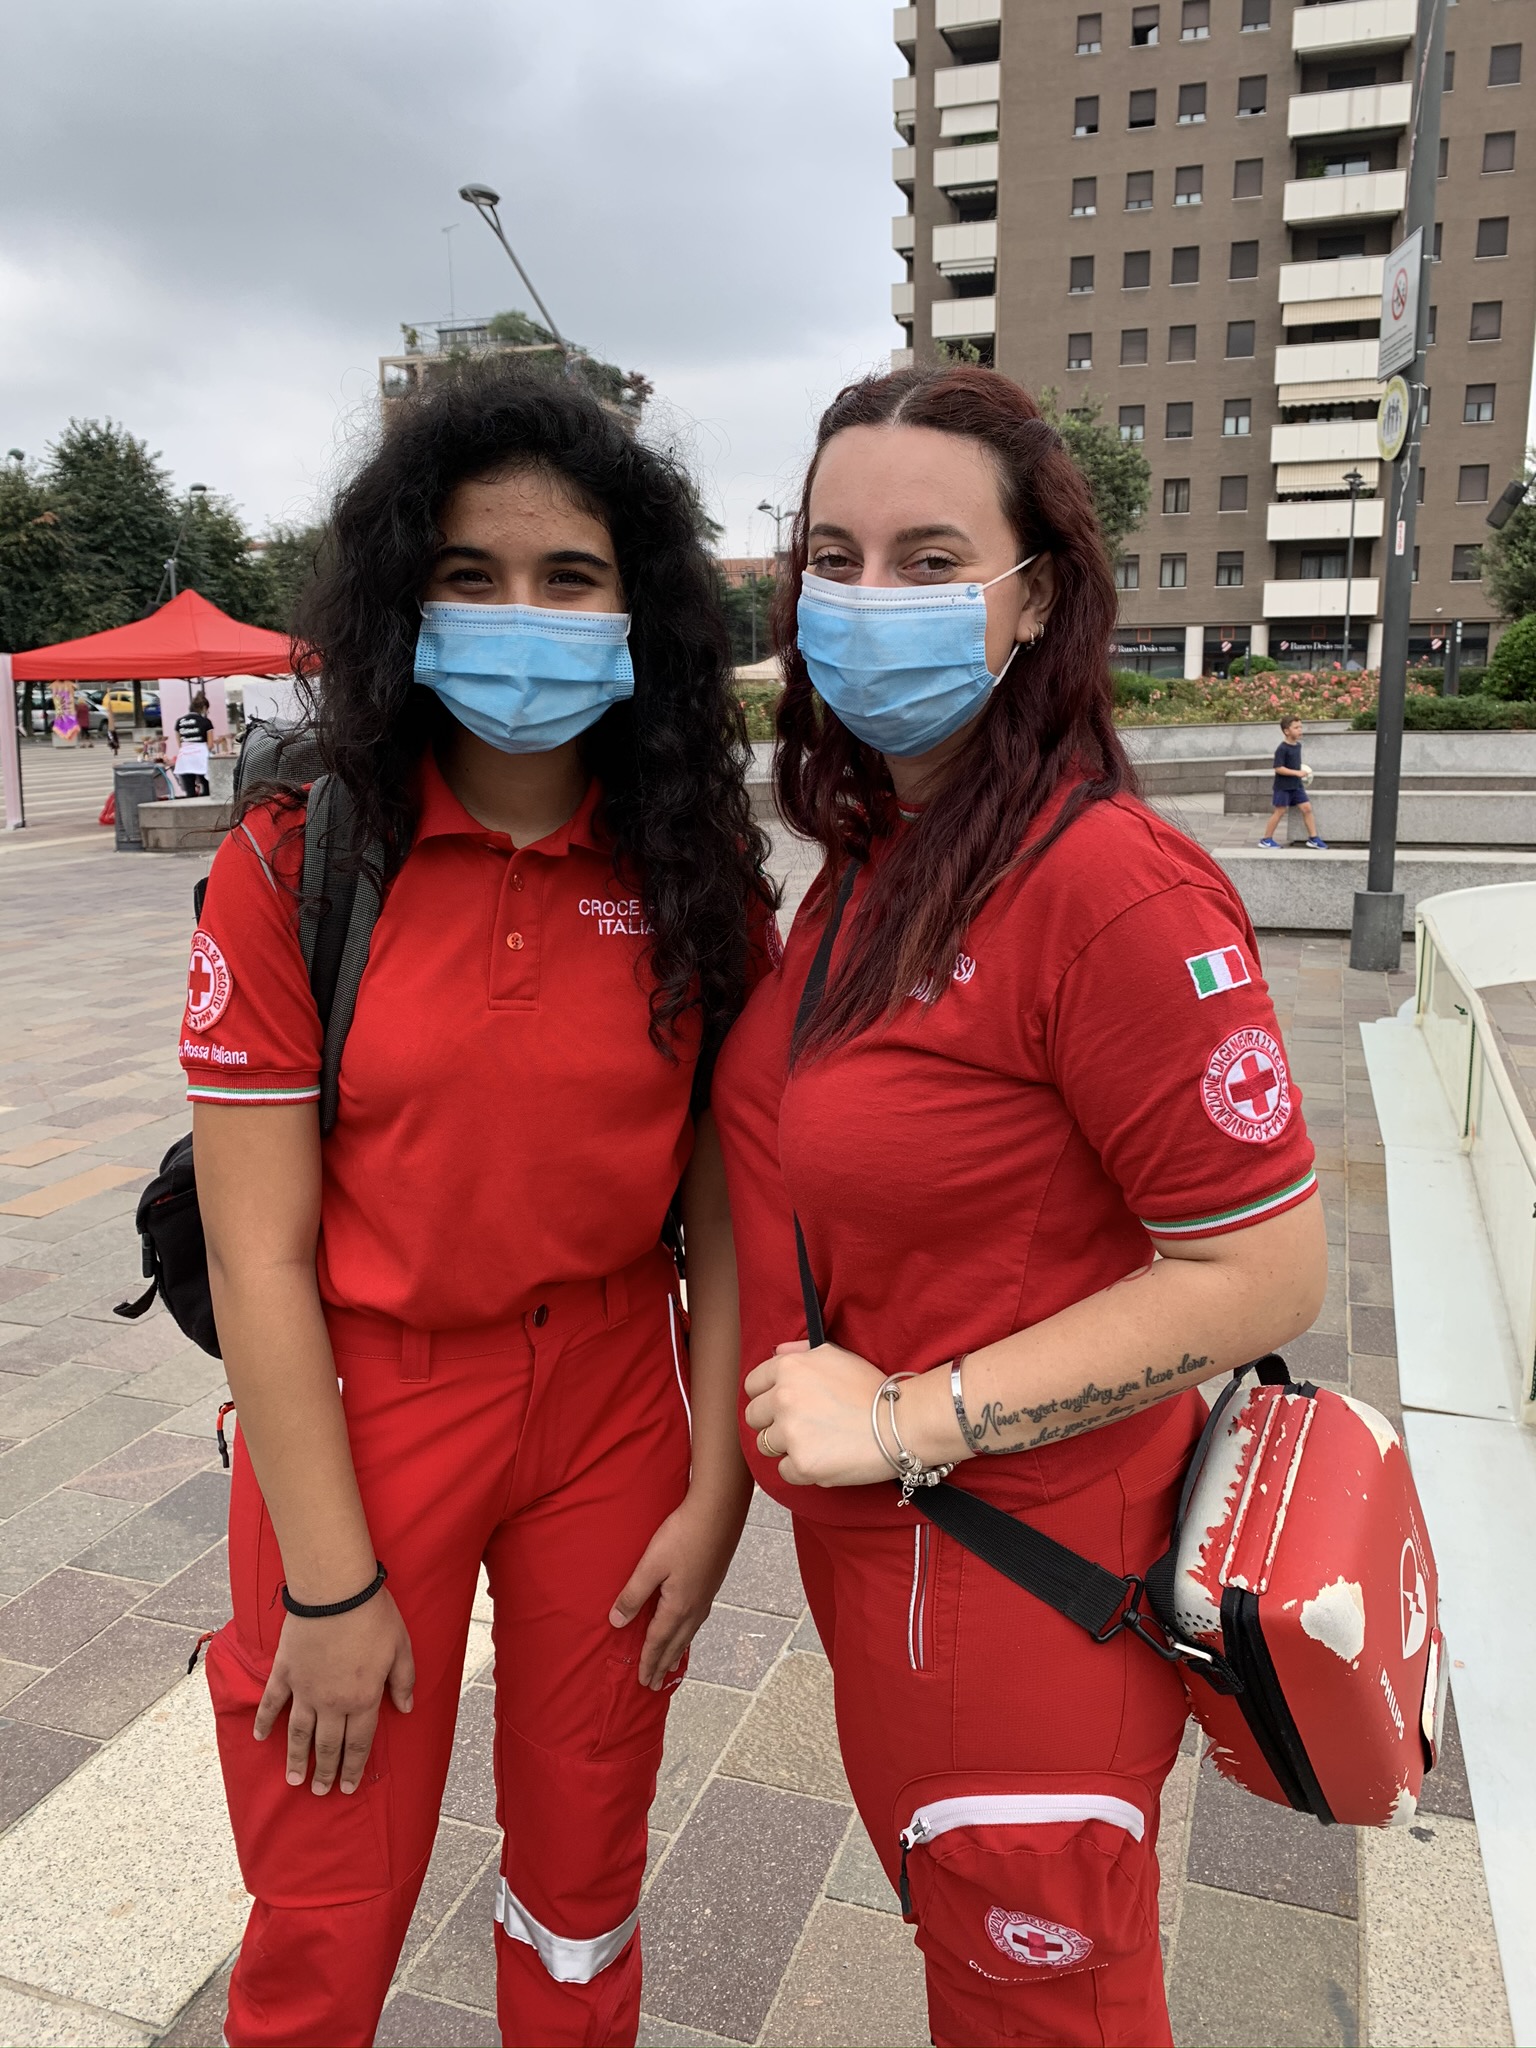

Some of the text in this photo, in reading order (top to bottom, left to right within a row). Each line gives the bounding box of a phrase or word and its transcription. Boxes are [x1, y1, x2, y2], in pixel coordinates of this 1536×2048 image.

[578, 898, 640, 917] CROCE
[598, 918, 658, 935] ITALIA
[211, 949, 220, 964] 22
[214, 966, 228, 1010] AGOSTO
[184, 1039, 210, 1060] Rossa
[211, 1043, 248, 1065] Italiana
[1217, 1031, 1261, 1061] GINEVRA
[1210, 1054, 1228, 1073] DI
[1271, 1046, 1290, 1104] AGOSTO
[1204, 1072, 1263, 1140] CONVENZIONE
[973, 1401, 1021, 1440] Never
[1021, 1400, 1058, 1423] regret
[1060, 1383, 1114, 1413] anything
[1112, 1382, 1140, 1402] you
[1145, 1366, 1174, 1388] have
[1030, 1427, 1061, 1447] what
[1380, 1667, 1405, 1741] PHILIPS
